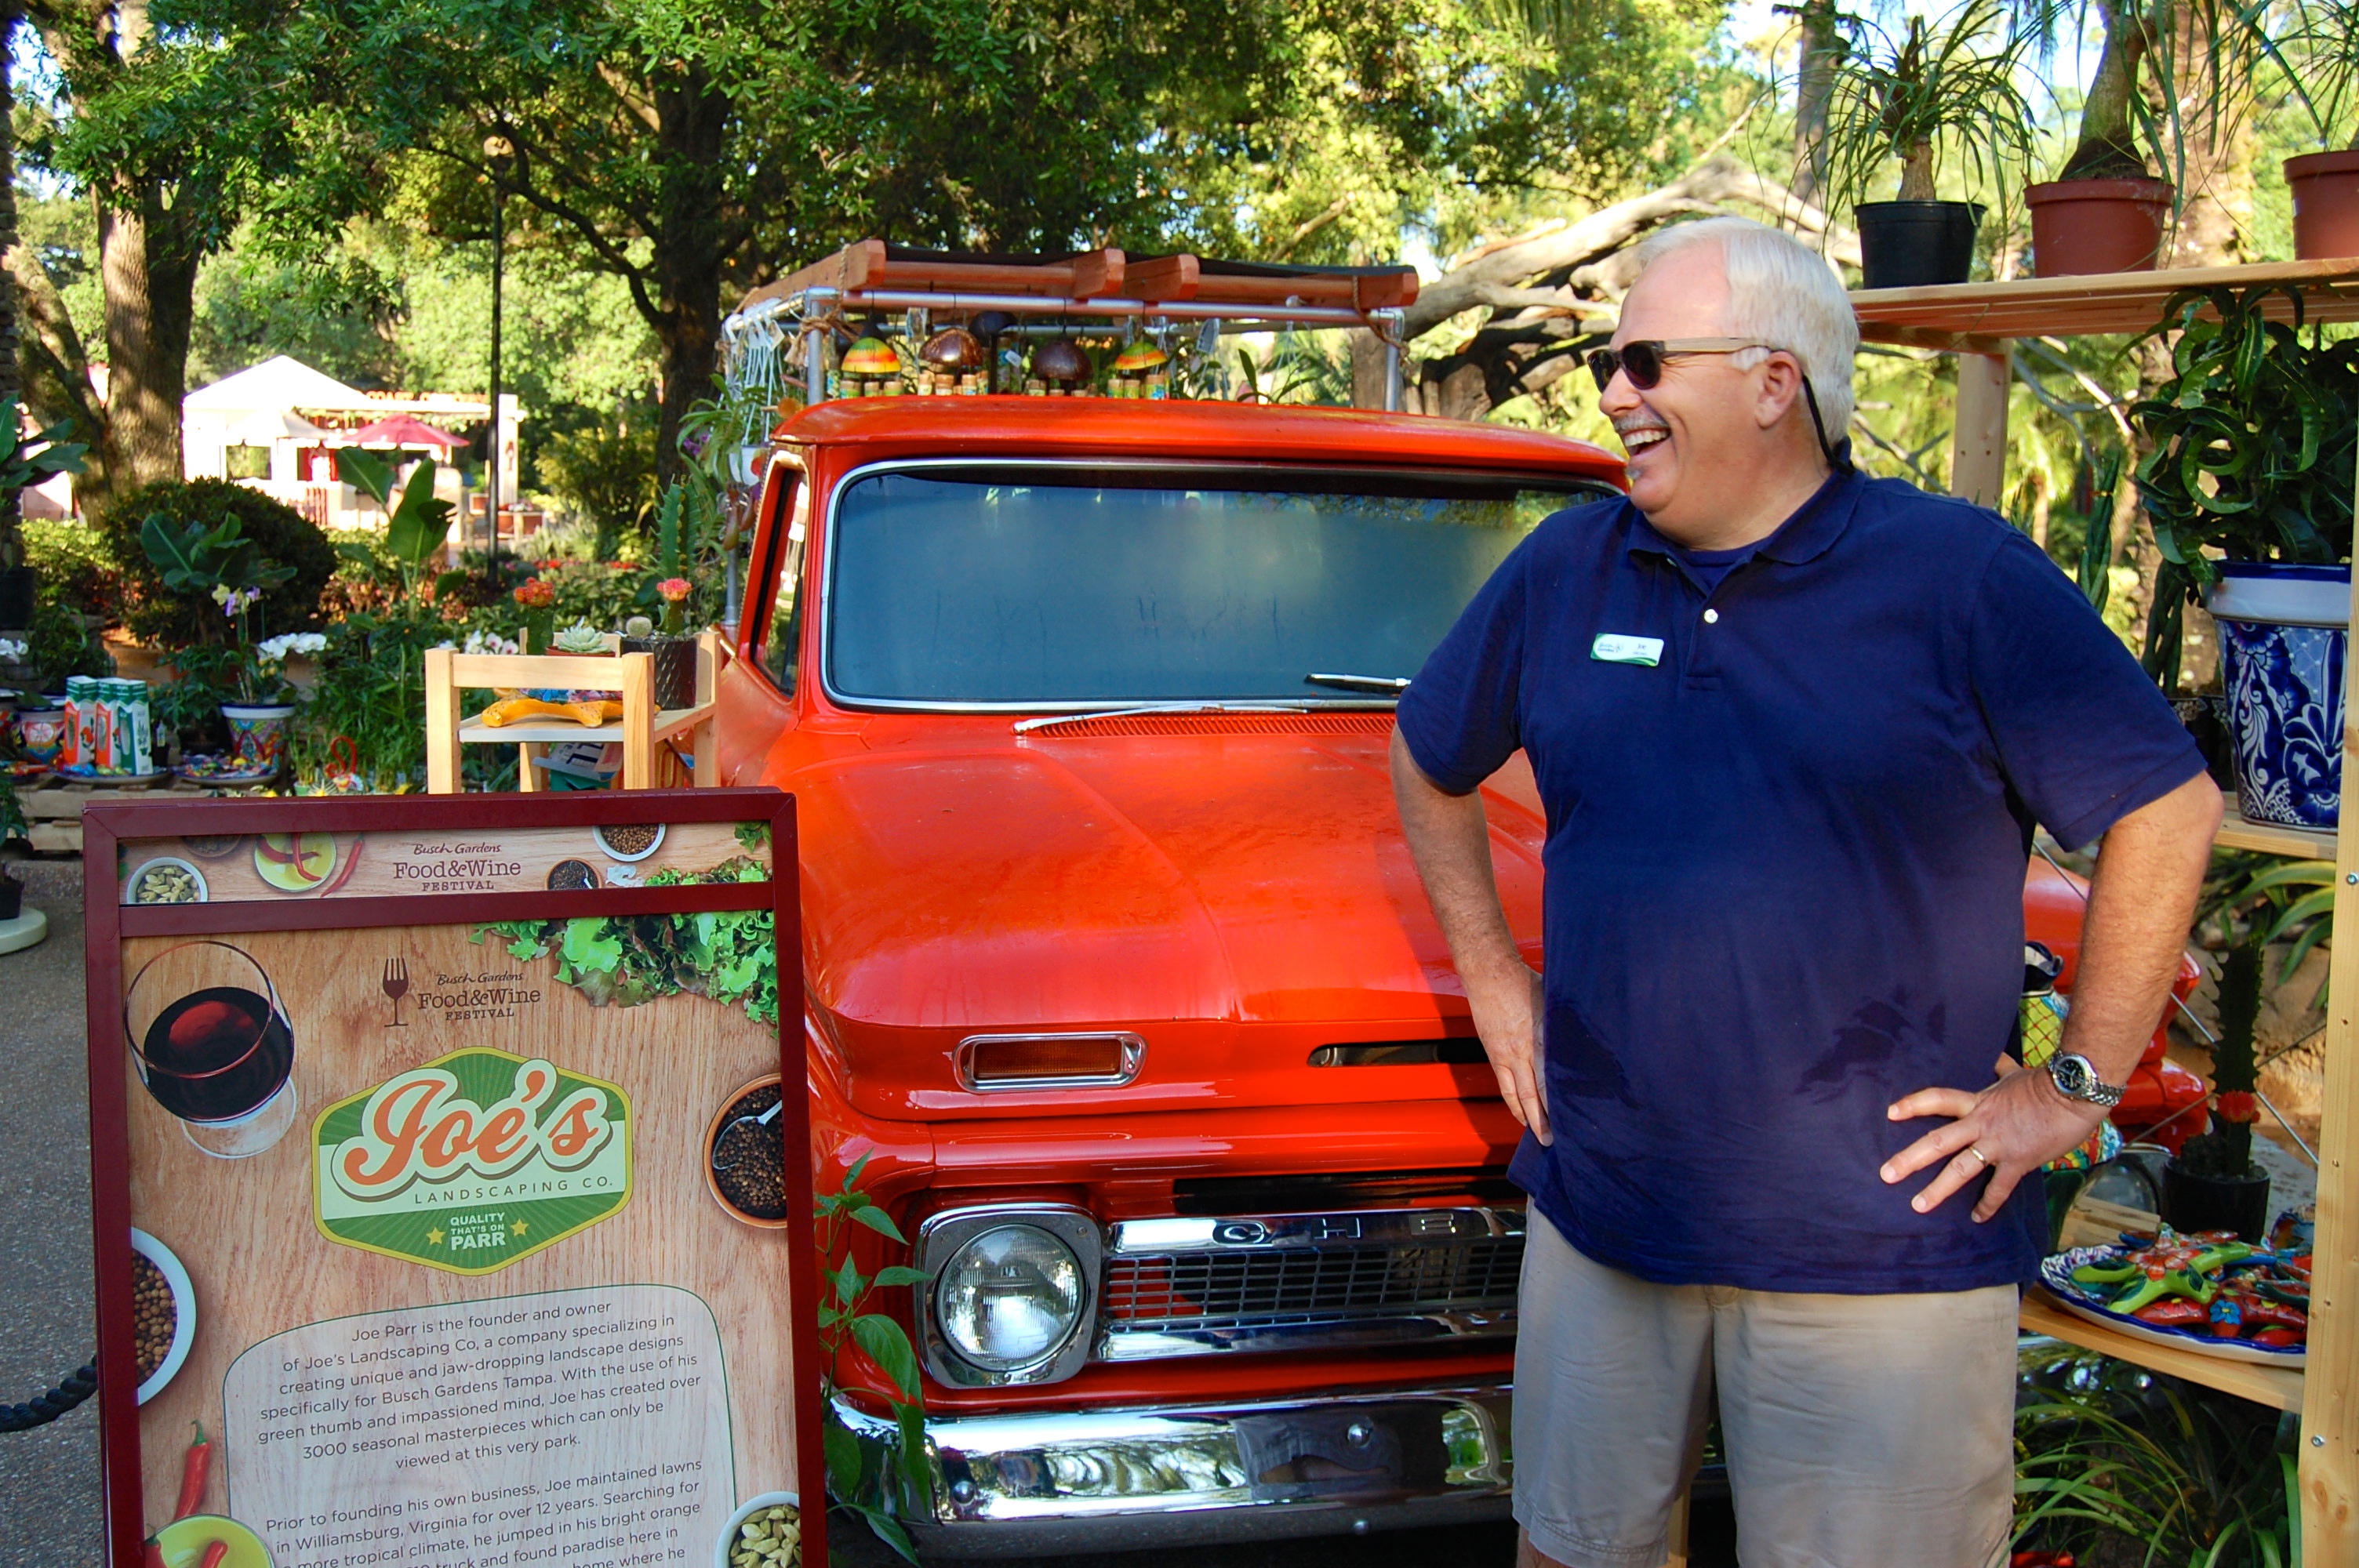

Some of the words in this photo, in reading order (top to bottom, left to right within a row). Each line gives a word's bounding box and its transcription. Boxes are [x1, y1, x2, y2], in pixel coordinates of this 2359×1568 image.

[413, 843, 453, 855] Busch
[455, 842, 501, 854] Gardens
[393, 860, 522, 879] Food&Wine
[422, 880, 494, 891] FESTIVAL
[436, 973, 475, 985] Busch
[478, 971, 524, 983] Gardens
[418, 989, 541, 1009] Food&Wine
[445, 1008, 514, 1021] FESTIVAL
[343, 1070, 599, 1185] Joe's
[414, 1180, 568, 1204] LANDSCAPING
[582, 1175, 613, 1188] CO.
[450, 1212, 505, 1226] QUALITY
[451, 1225, 486, 1235] THAT'S
[489, 1222, 505, 1232] ON
[450, 1233, 506, 1250] PARR
[352, 1329, 380, 1341] Joe
[385, 1325, 417, 1338] Parr
[423, 1321, 434, 1334] is
[439, 1319, 463, 1331] the
[468, 1311, 529, 1328] founder
[533, 1306, 560, 1320] and
[565, 1303, 611, 1316] owner
[283, 1358, 300, 1371] of
[305, 1354, 345, 1370] Joe's
[351, 1343, 449, 1363] Landscaping
[485, 1338, 493, 1348] a
[498, 1330, 567, 1346] company
[572, 1319, 656, 1339] specializing
[662, 1314, 674, 1327] in
[279, 1377, 344, 1395] creating
[351, 1371, 404, 1386] unique
[409, 1364, 438, 1379] and
[442, 1353, 544, 1377] jaw-dropping
[550, 1344, 623, 1362] landscape
[628, 1337, 683, 1352] designs
[260, 1397, 349, 1421] specifically
[354, 1395, 376, 1407] for
[383, 1387, 429, 1404] Busch
[434, 1381, 498, 1397] Gardens
[503, 1374, 556, 1388] Tampa.
[562, 1367, 596, 1381] With
[602, 1364, 624, 1377] the
[630, 1362, 654, 1373] use
[659, 1356, 674, 1369] of
[678, 1355, 697, 1367] his
[259, 1428, 304, 1445] green
[310, 1418, 362, 1436] thumb
[367, 1412, 396, 1428] and
[402, 1399, 498, 1424] impassioned
[503, 1394, 544, 1410] mind,
[550, 1392, 576, 1405] Joe
[581, 1388, 605, 1400] has
[610, 1378, 665, 1396] created
[670, 1376, 700, 1388] over
[304, 1442, 347, 1459] 3000
[353, 1432, 420, 1453] seasonal
[425, 1421, 525, 1443] masterpieces
[531, 1412, 574, 1428] which
[580, 1410, 605, 1422] can
[610, 1403, 641, 1417] only
[646, 1401, 663, 1413] be
[395, 1450, 449, 1468] viewed
[455, 1448, 471, 1461] at
[475, 1443, 503, 1458] this
[507, 1441, 540, 1454] very
[544, 1433, 580, 1451] park.
[267, 1518, 304, 1532] Prior
[310, 1515, 326, 1526] to
[332, 1504, 402, 1523] founding
[408, 1498, 429, 1512] his
[434, 1495, 467, 1508] own
[471, 1485, 540, 1502] business,
[545, 1480, 571, 1492] Joe
[576, 1464, 656, 1487] maintained
[662, 1461, 702, 1475] lawns
[277, 1541, 290, 1553] in
[296, 1527, 403, 1550] Williamsburg,
[409, 1515, 467, 1534] Virginia
[472, 1512, 493, 1524] for
[499, 1507, 532, 1520] over
[536, 1502, 551, 1515] 12
[555, 1498, 598, 1515] years.
[603, 1486, 674, 1505] Searching
[680, 1481, 700, 1494] for
[298, 1559, 339, 1568] more
[344, 1545, 403, 1566] tropical
[409, 1539, 469, 1559] climate,
[474, 1534, 493, 1547] he
[497, 1523, 554, 1545] jumped
[559, 1522, 571, 1534] in
[576, 1518, 597, 1530] his
[602, 1510, 645, 1526] bright
[650, 1504, 700, 1519] orange
[480, 1552, 508, 1568] and
[514, 1544, 557, 1563] found
[562, 1536, 624, 1557] paradise
[630, 1531, 661, 1544] here
[666, 1527, 678, 1538] in
[619, 1552, 663, 1567] where
[668, 1548, 685, 1559] he
